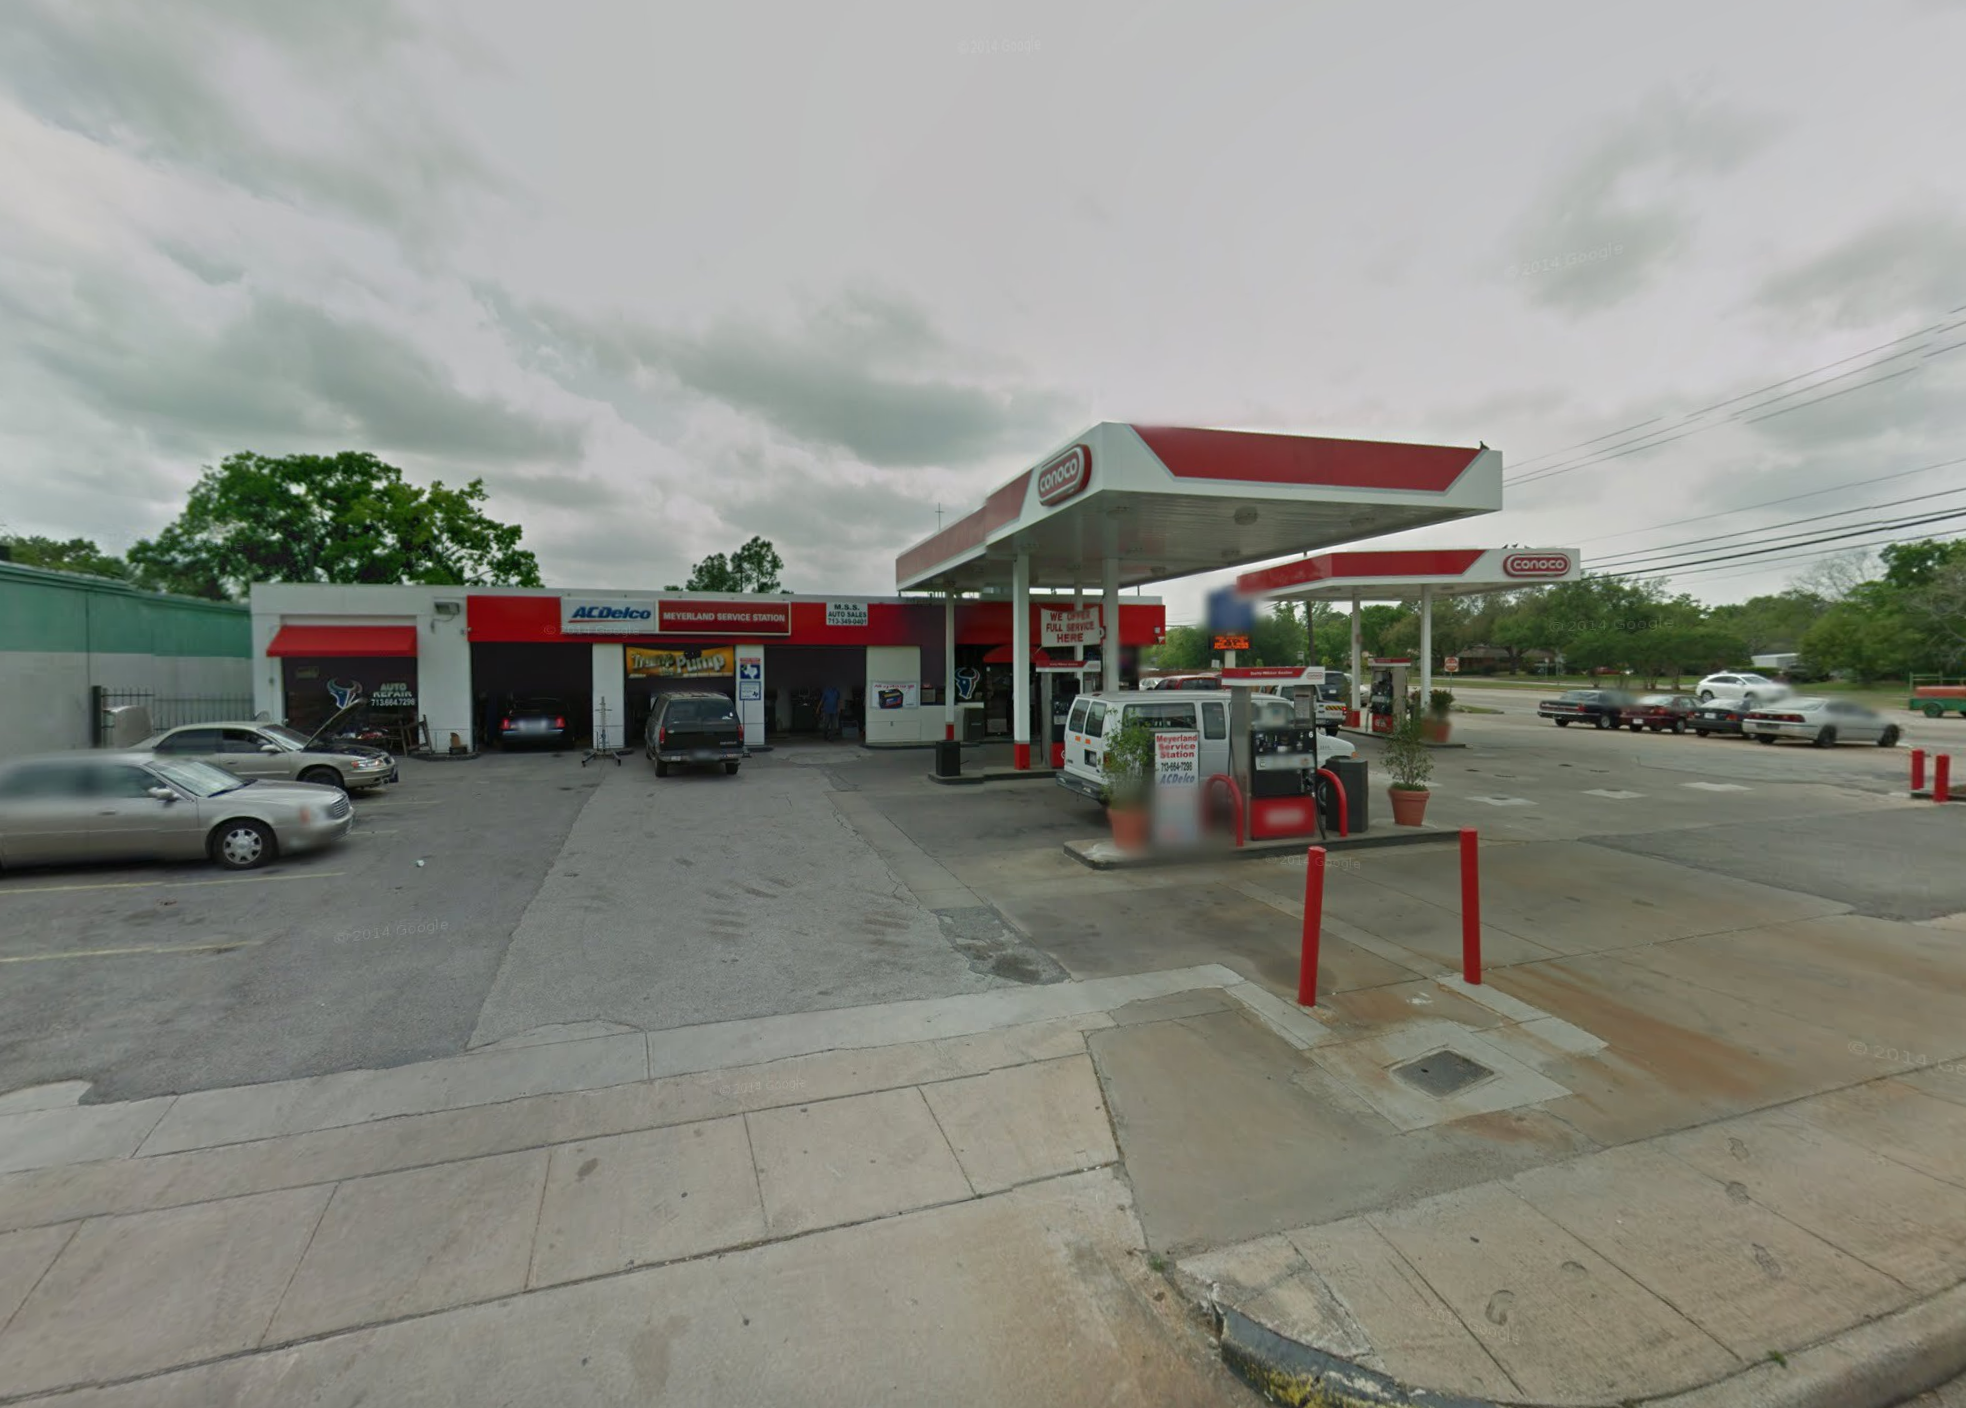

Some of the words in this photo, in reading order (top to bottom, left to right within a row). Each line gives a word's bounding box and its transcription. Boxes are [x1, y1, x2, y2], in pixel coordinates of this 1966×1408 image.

[834, 603, 860, 611] M.S.S.
[571, 606, 652, 620] ACDelco
[663, 612, 715, 622] MEYERLAND
[717, 613, 751, 622] SERVICE
[753, 613, 786, 622] STATION
[1050, 612, 1062, 621] WE
[1067, 611, 1090, 620] OFFER
[1046, 623, 1063, 632] FULL
[1066, 621, 1094, 631] SERVICE
[1057, 633, 1083, 643] HERE
[675, 654, 725, 673] Pump
[380, 682, 407, 691] AUTO
[1156, 734, 1198, 744] Meyerland
[1158, 743, 1196, 751] Service
[1160, 751, 1195, 759] Station
[1159, 772, 1196, 785] ACDelco
